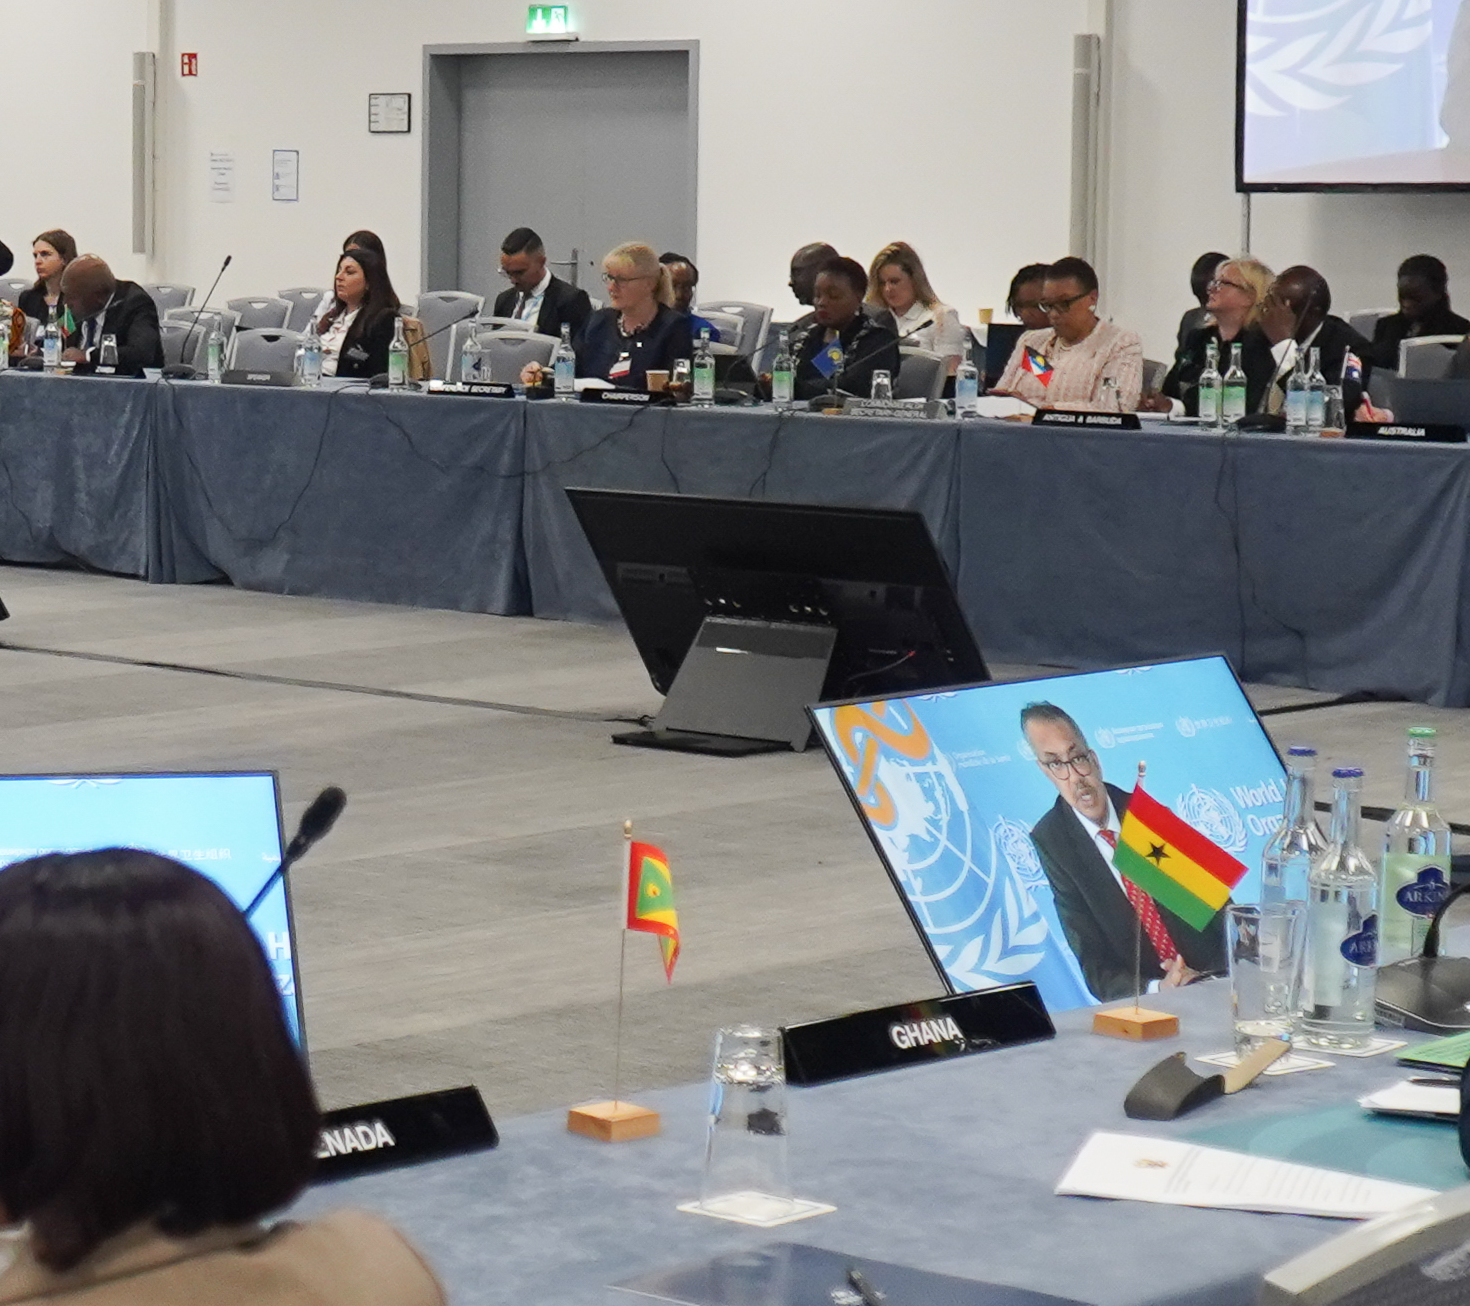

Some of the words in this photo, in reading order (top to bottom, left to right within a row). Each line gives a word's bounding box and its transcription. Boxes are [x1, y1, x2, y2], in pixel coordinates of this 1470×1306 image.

[1377, 426, 1426, 437] AUSTRALIA
[891, 1017, 965, 1049] GHANA
[318, 1122, 396, 1159] NADA
